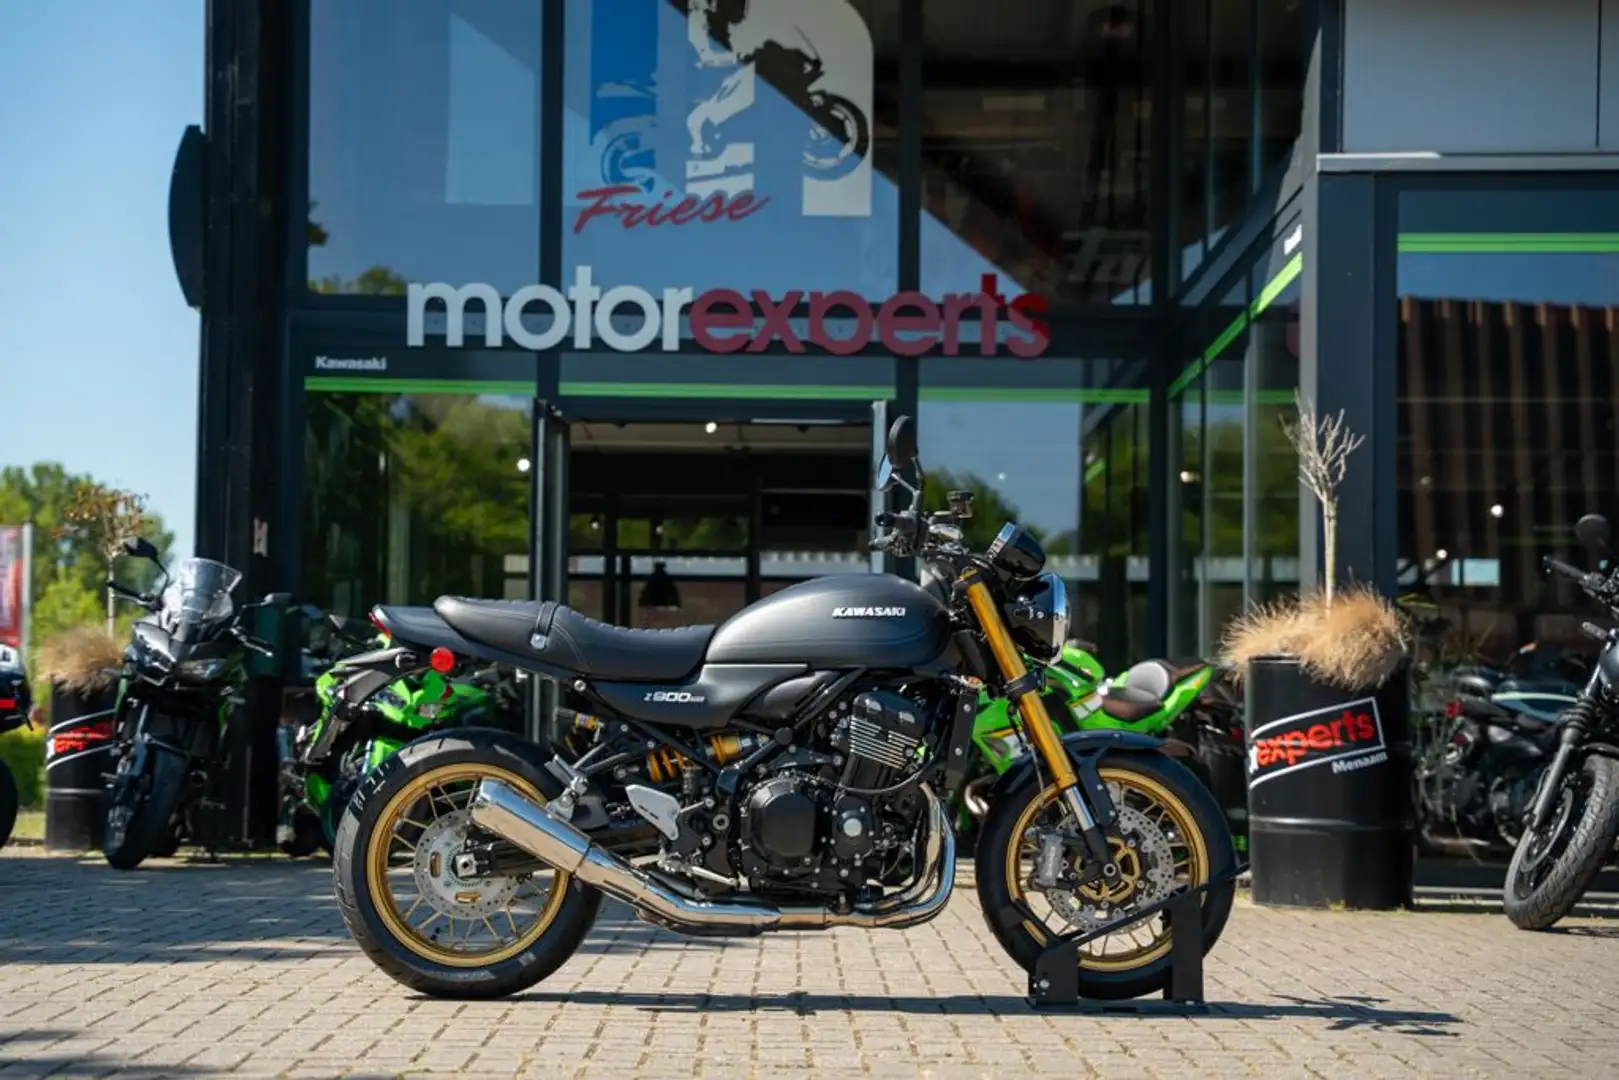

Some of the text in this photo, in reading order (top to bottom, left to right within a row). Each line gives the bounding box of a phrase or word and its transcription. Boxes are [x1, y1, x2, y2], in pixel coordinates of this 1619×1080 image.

[574, 184, 771, 235] Friese
[406, 265, 1051, 358] motorexperts
[315, 355, 387, 370] Kawasaki
[832, 607, 906, 617] KAWASAKI
